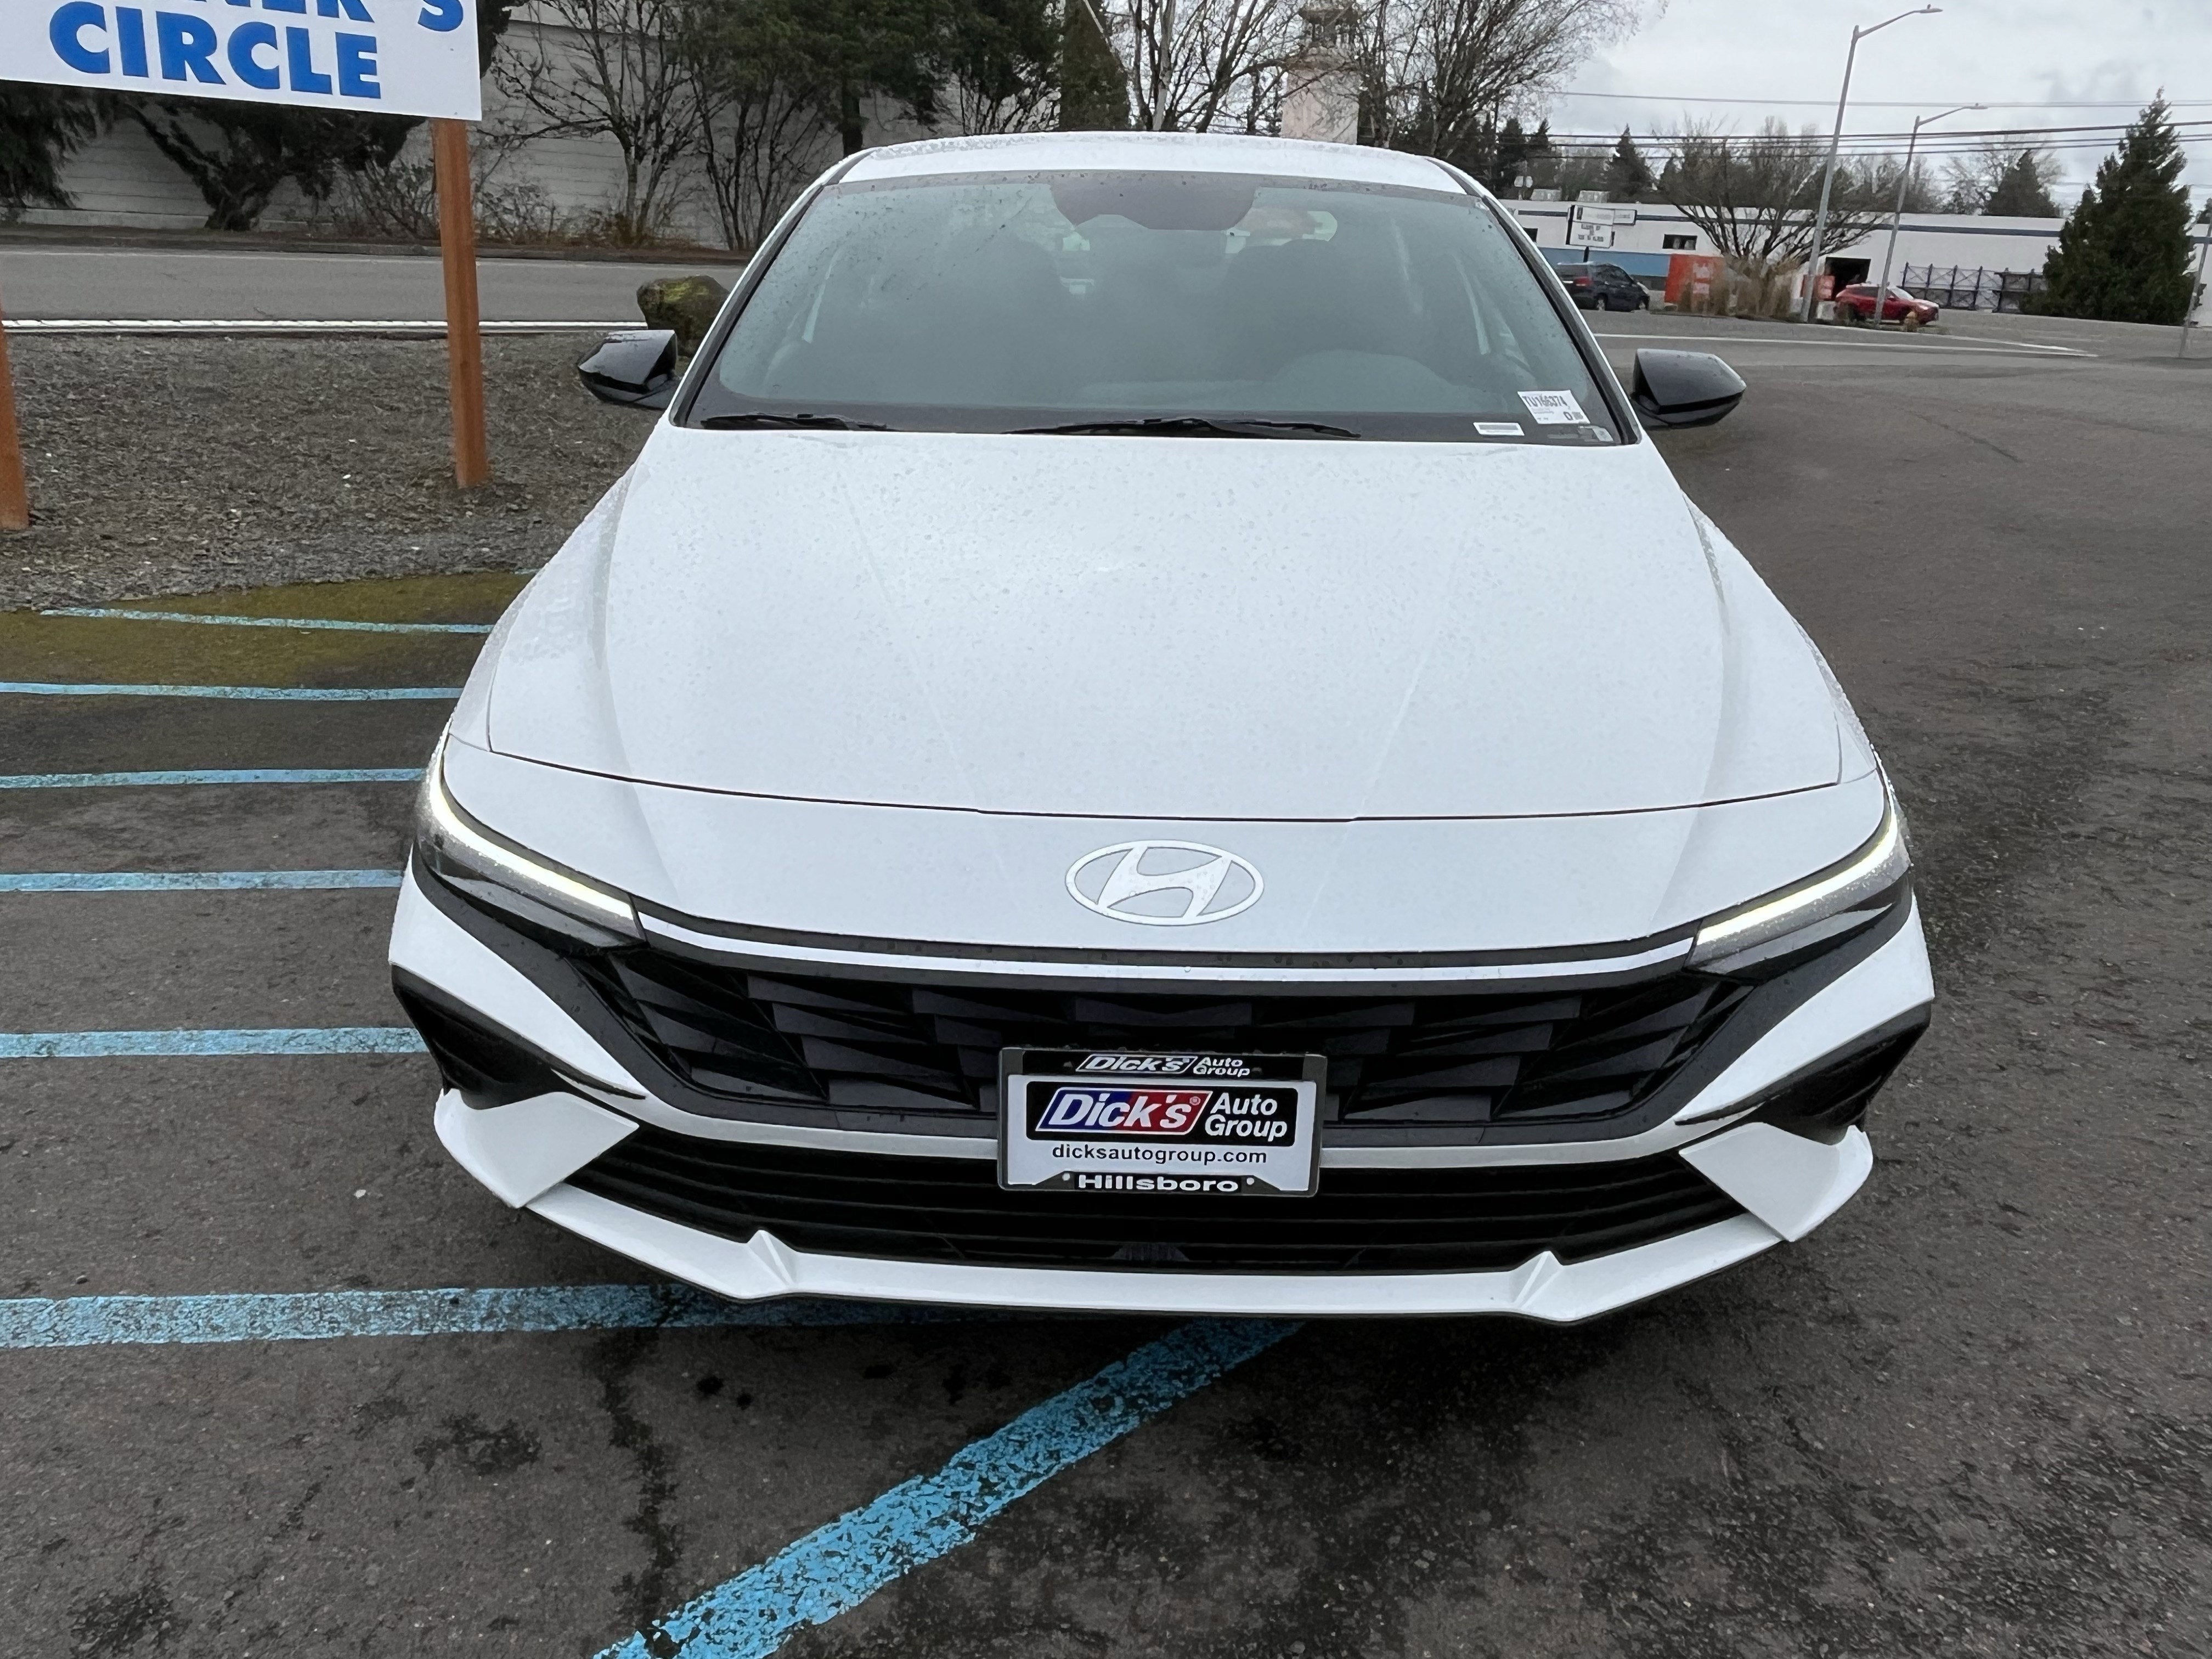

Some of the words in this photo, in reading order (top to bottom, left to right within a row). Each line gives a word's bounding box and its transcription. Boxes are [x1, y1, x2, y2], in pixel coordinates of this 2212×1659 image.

[49, 1, 381, 99] CIRCLE
[1085, 1056, 1184, 1071] Dick's
[1193, 1065, 1250, 1077] Group
[1199, 1057, 1243, 1068] Auto
[1048, 1092, 1192, 1128] Dick's
[1210, 1092, 1278, 1116] Auto
[1205, 1114, 1288, 1142] Group
[1052, 1144, 1267, 1165] dicksautogroup.com
[1078, 1175, 1239, 1192] Hillsboro
